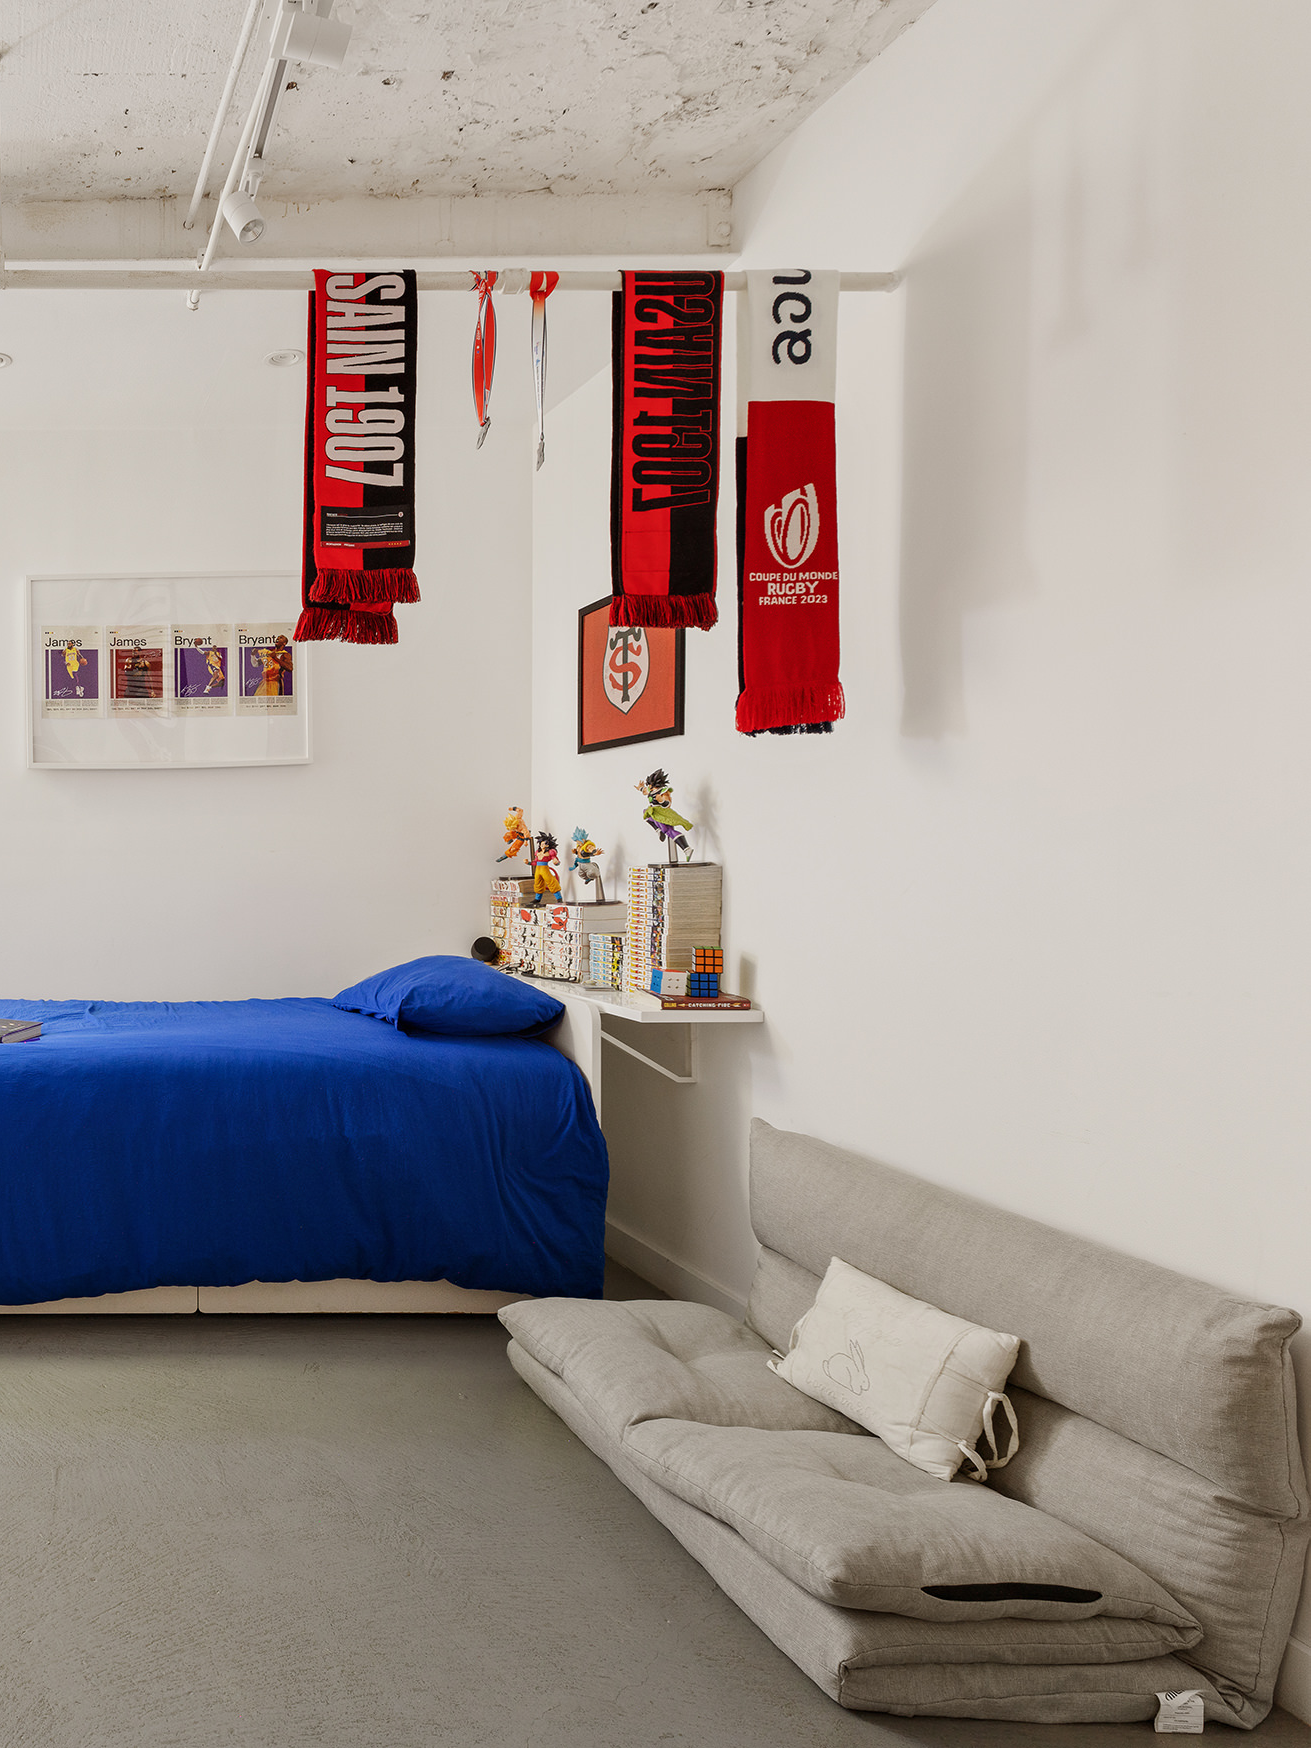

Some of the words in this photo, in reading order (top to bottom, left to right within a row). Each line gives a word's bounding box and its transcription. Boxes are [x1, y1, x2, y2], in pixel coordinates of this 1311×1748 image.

[324, 385, 406, 487] 1907
[749, 572, 782, 582] COUPE
[782, 572, 797, 582] DU
[798, 571, 838, 581] MONDE
[767, 581, 820, 595] RUGBY
[758, 596, 798, 605] FRANCE
[800, 594, 828, 604] 2023
[109, 636, 147, 647] James
[174, 635, 212, 648] Brynt
[238, 634, 277, 647] Bryant
